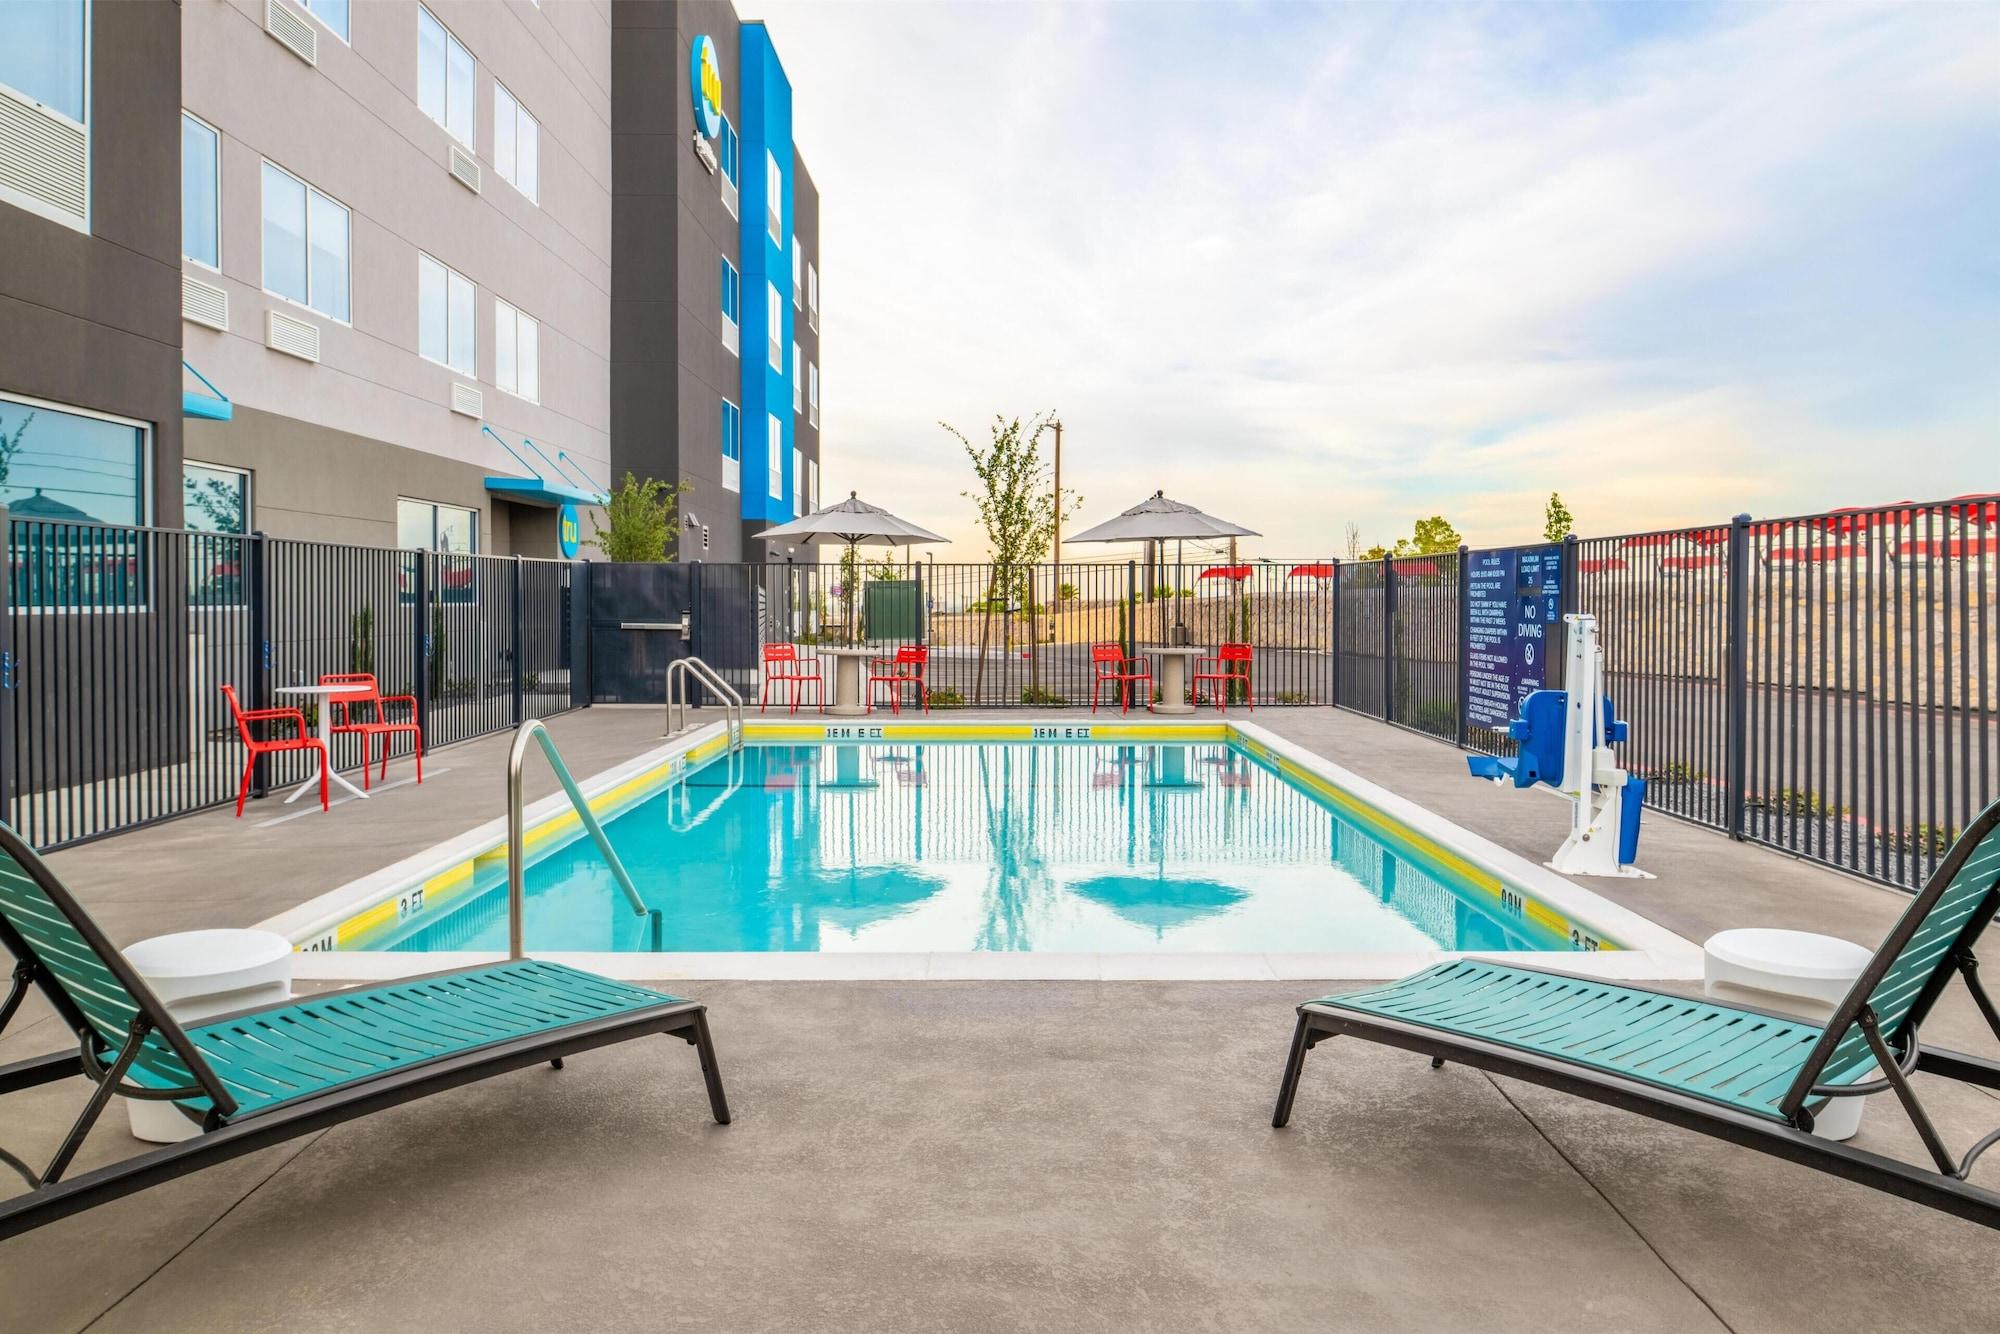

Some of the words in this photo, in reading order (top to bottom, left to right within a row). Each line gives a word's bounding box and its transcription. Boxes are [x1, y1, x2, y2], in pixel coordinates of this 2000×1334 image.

[562, 515, 577, 544] tru
[1521, 555, 1540, 563] MAXIMUM
[1521, 565, 1531, 573] LOAD
[1531, 565, 1540, 573] LIMIT
[1525, 605, 1536, 619] NO
[1518, 624, 1542, 638] DIVING
[1524, 678, 1539, 687] WARNING
[412, 889, 424, 910] FT
[1585, 936, 1598, 952] FT
